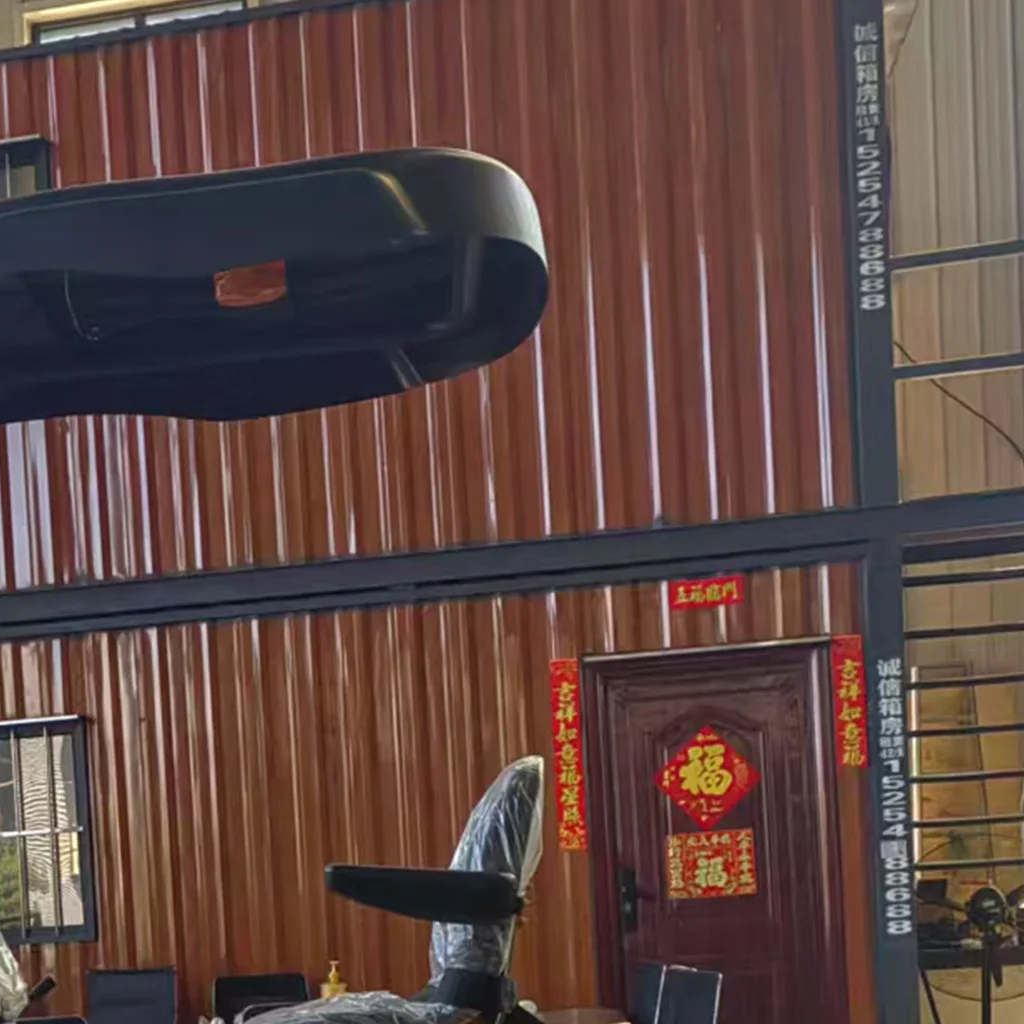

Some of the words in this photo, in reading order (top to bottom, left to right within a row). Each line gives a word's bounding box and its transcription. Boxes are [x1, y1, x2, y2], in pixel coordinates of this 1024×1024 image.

[679, 743, 733, 796] 福
[694, 856, 728, 888] 福
[880, 759, 913, 936] 1525488668
